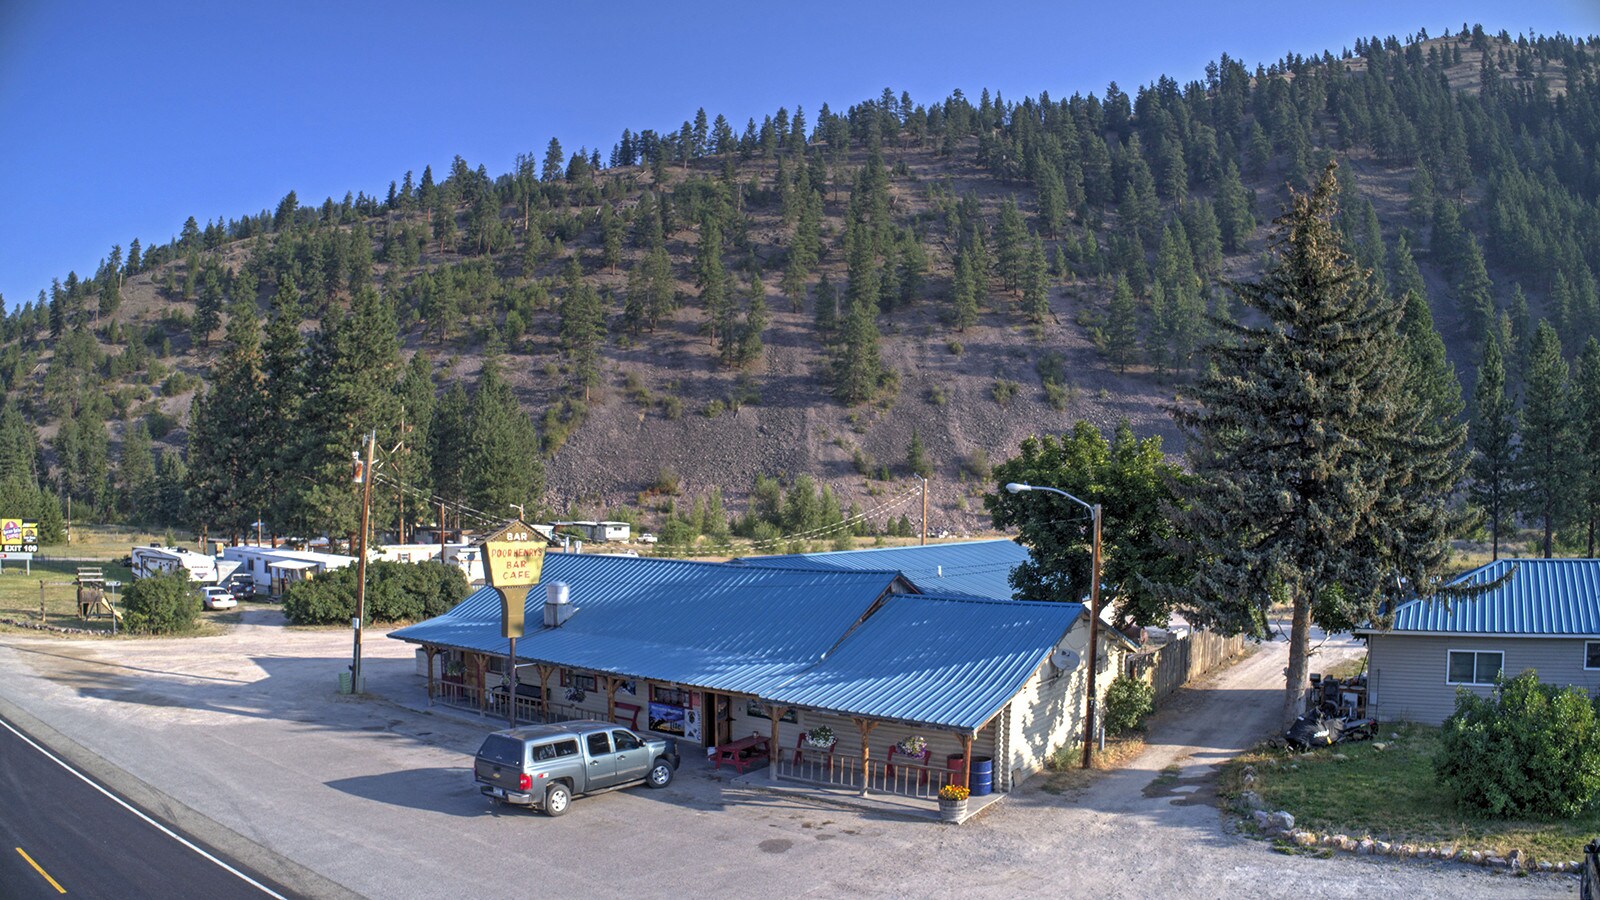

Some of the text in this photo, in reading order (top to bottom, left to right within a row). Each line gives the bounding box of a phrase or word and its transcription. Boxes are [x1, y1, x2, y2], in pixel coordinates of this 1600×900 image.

[506, 532, 528, 541] BAR
[4, 544, 38, 552] EXIT 109
[491, 547, 543, 558] POOR HENRY'S
[506, 560, 527, 569] BAR
[503, 571, 531, 580] CAFE
